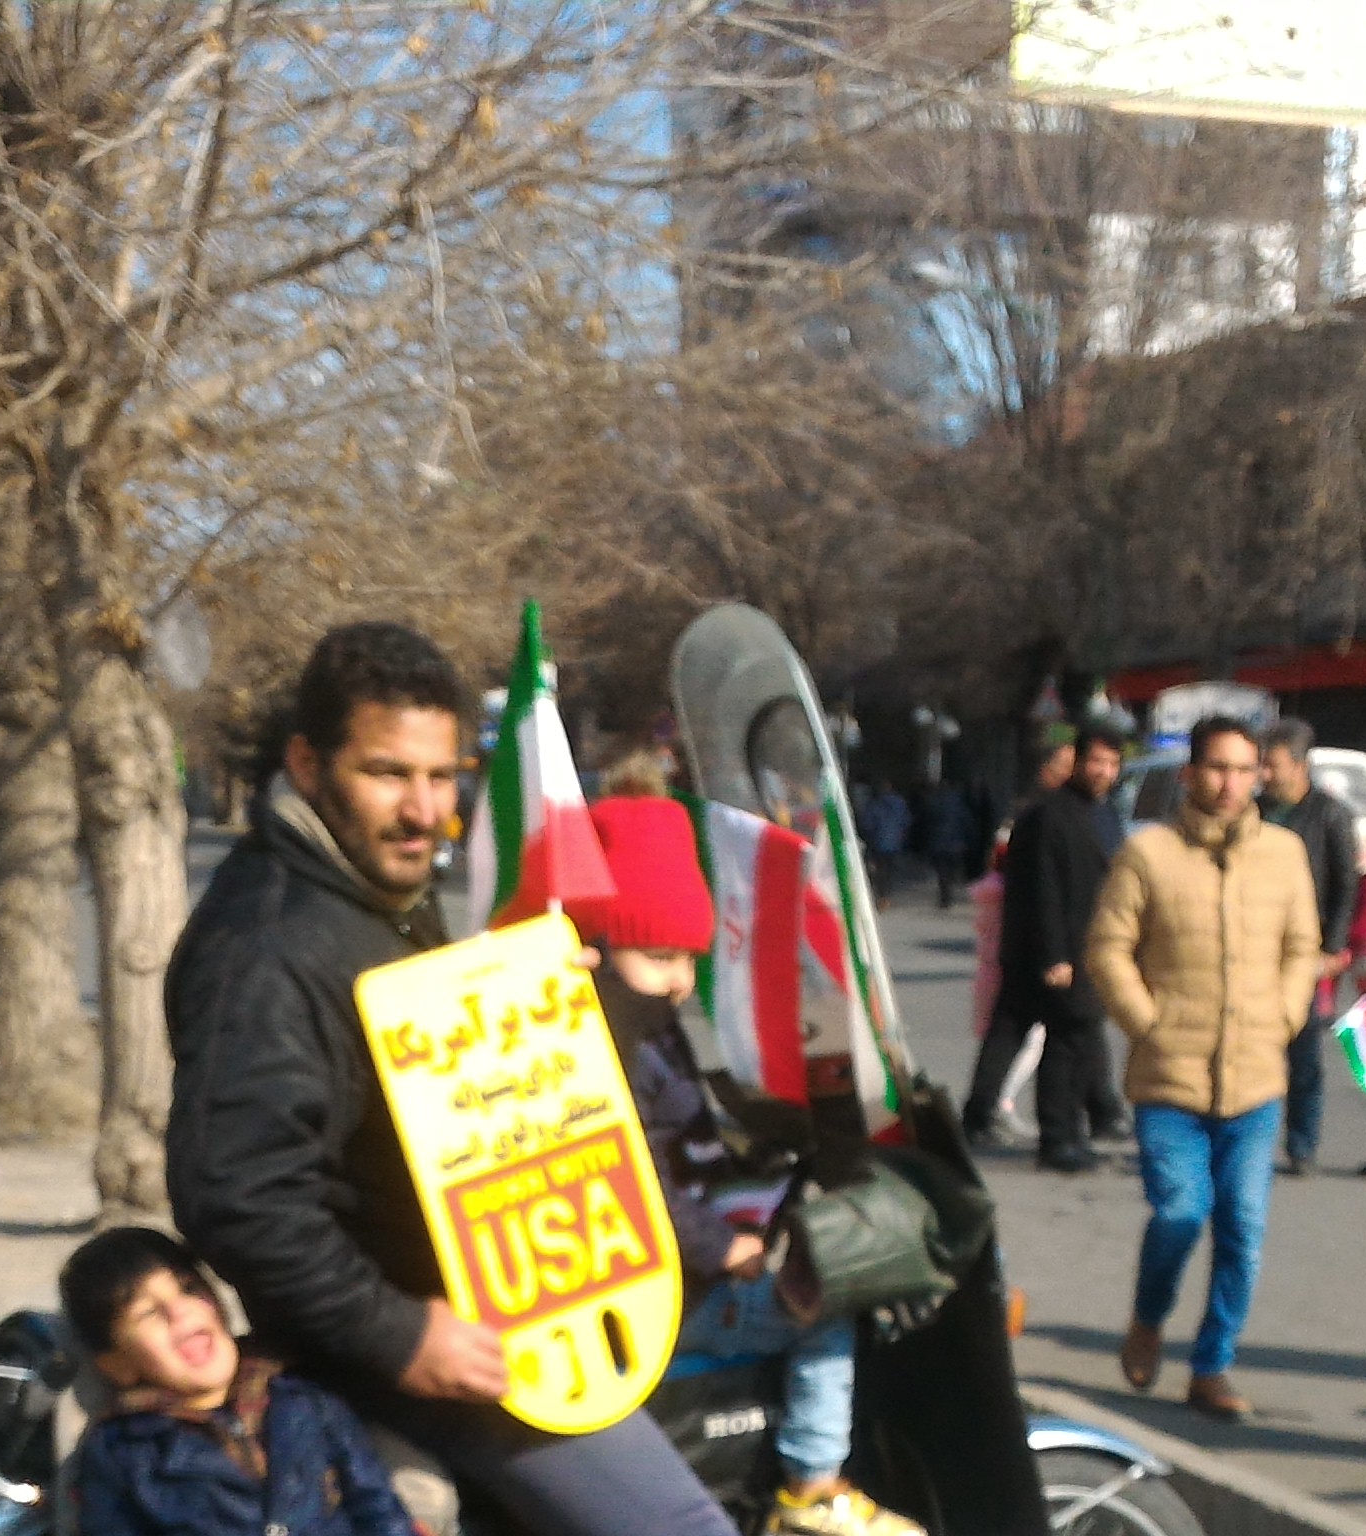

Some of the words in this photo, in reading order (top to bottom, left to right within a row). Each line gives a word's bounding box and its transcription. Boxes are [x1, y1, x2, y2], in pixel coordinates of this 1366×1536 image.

[500, 1003, 525, 1055] بر
[461, 1166, 549, 1220] DOWN
[547, 1138, 622, 1187] WITH
[471, 1175, 649, 1316] USA
[702, 1405, 767, 1439] HON
